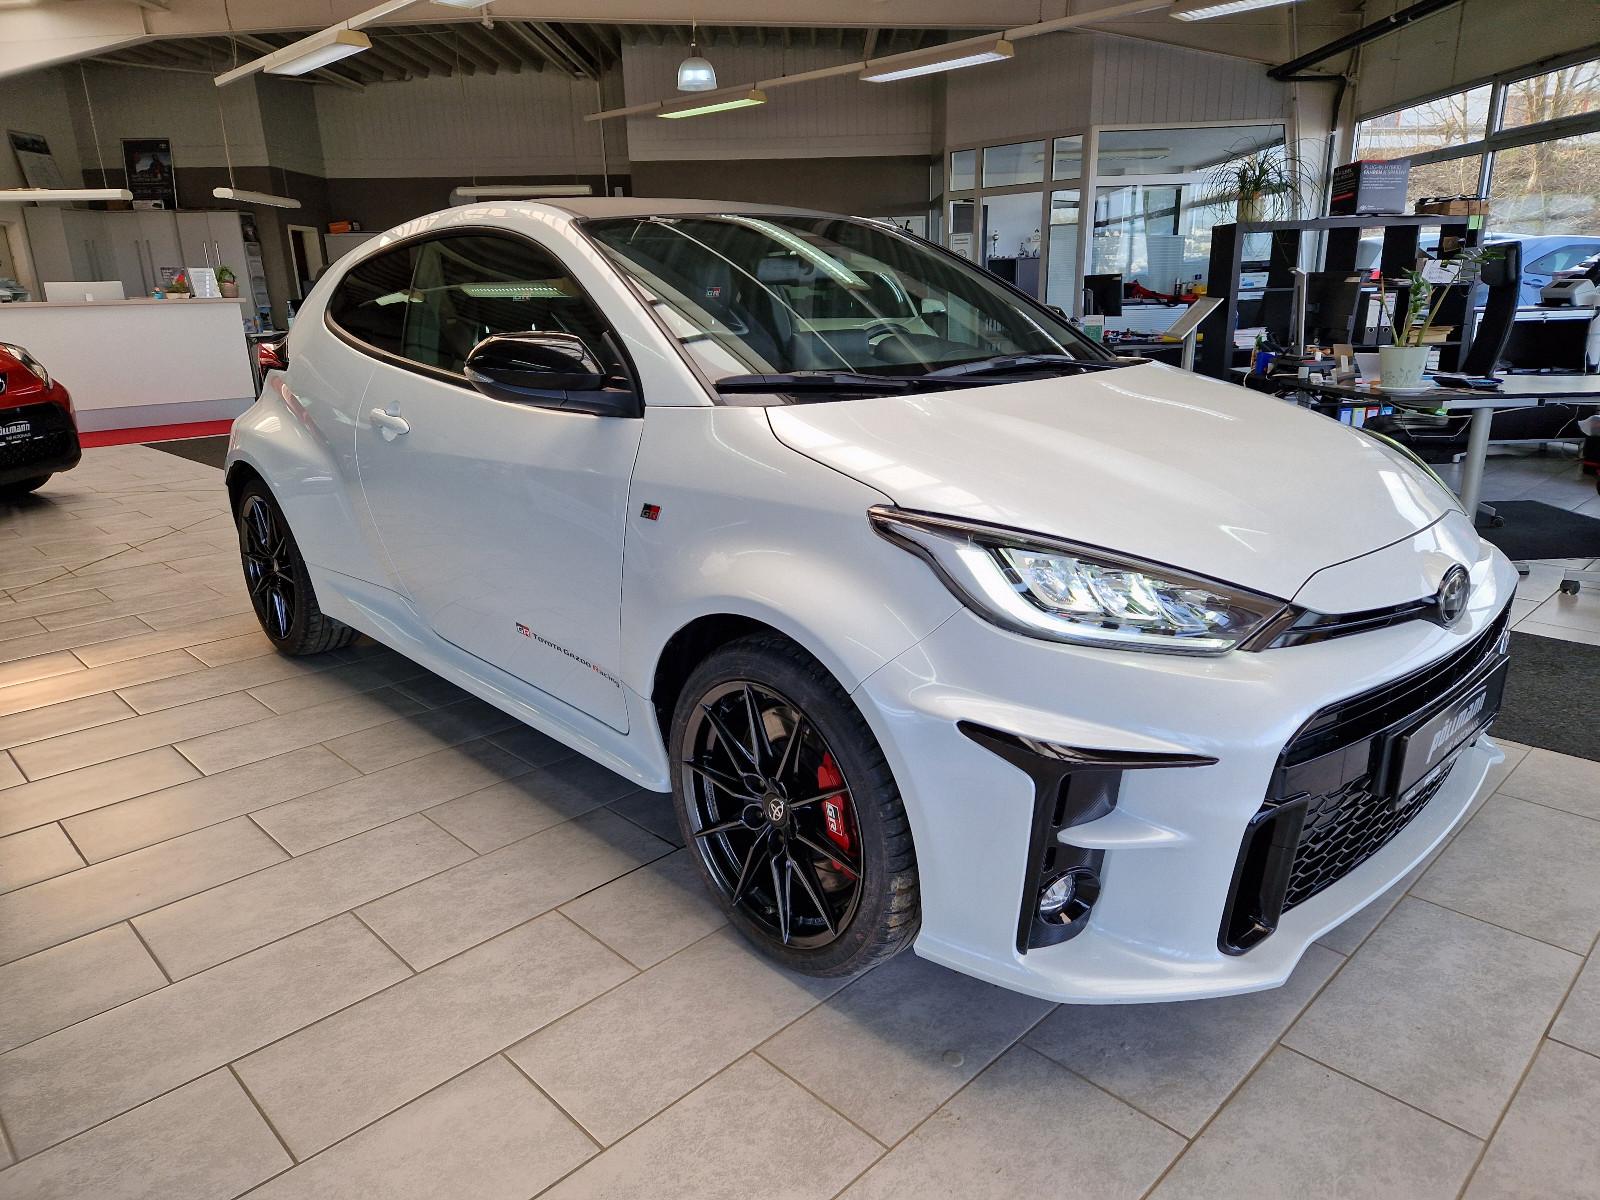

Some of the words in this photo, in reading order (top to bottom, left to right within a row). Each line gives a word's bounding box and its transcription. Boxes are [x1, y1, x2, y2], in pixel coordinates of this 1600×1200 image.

[706, 288, 720, 297] GR
[641, 507, 659, 520] GR
[516, 624, 531, 638] GR
[827, 803, 838, 832] GR
